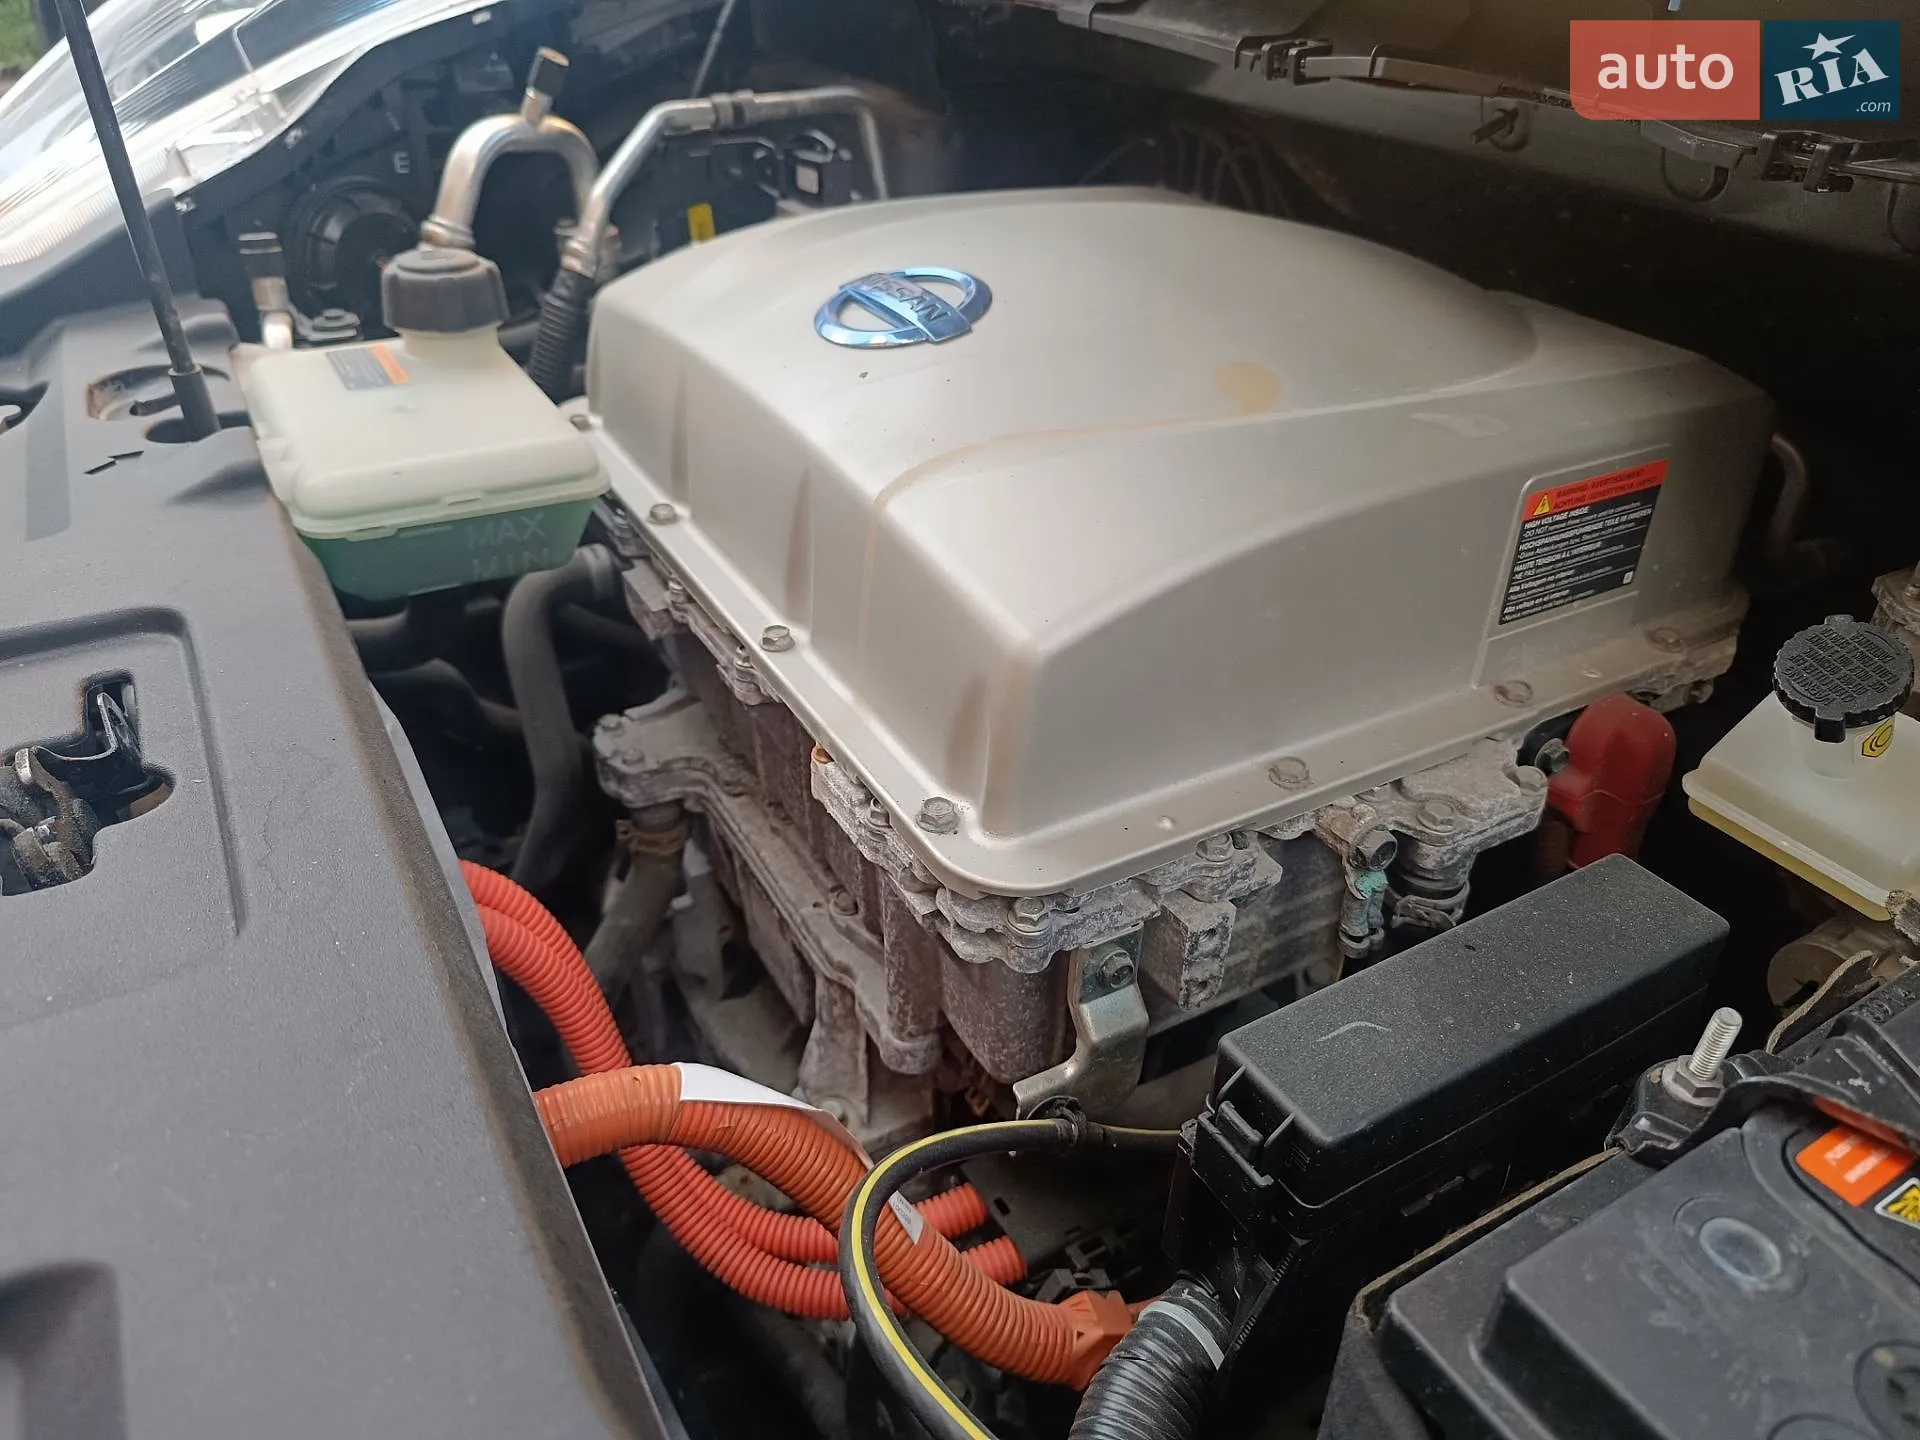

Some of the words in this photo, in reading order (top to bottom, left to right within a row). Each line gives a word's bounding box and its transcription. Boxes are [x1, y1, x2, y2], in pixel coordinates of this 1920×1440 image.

[466, 512, 546, 549] MAX
[1524, 520, 1540, 529] HIGH
[1542, 512, 1568, 525] VOLTAGE
[1569, 506, 1589, 517] INSIDE
[472, 547, 549, 581] MIN
